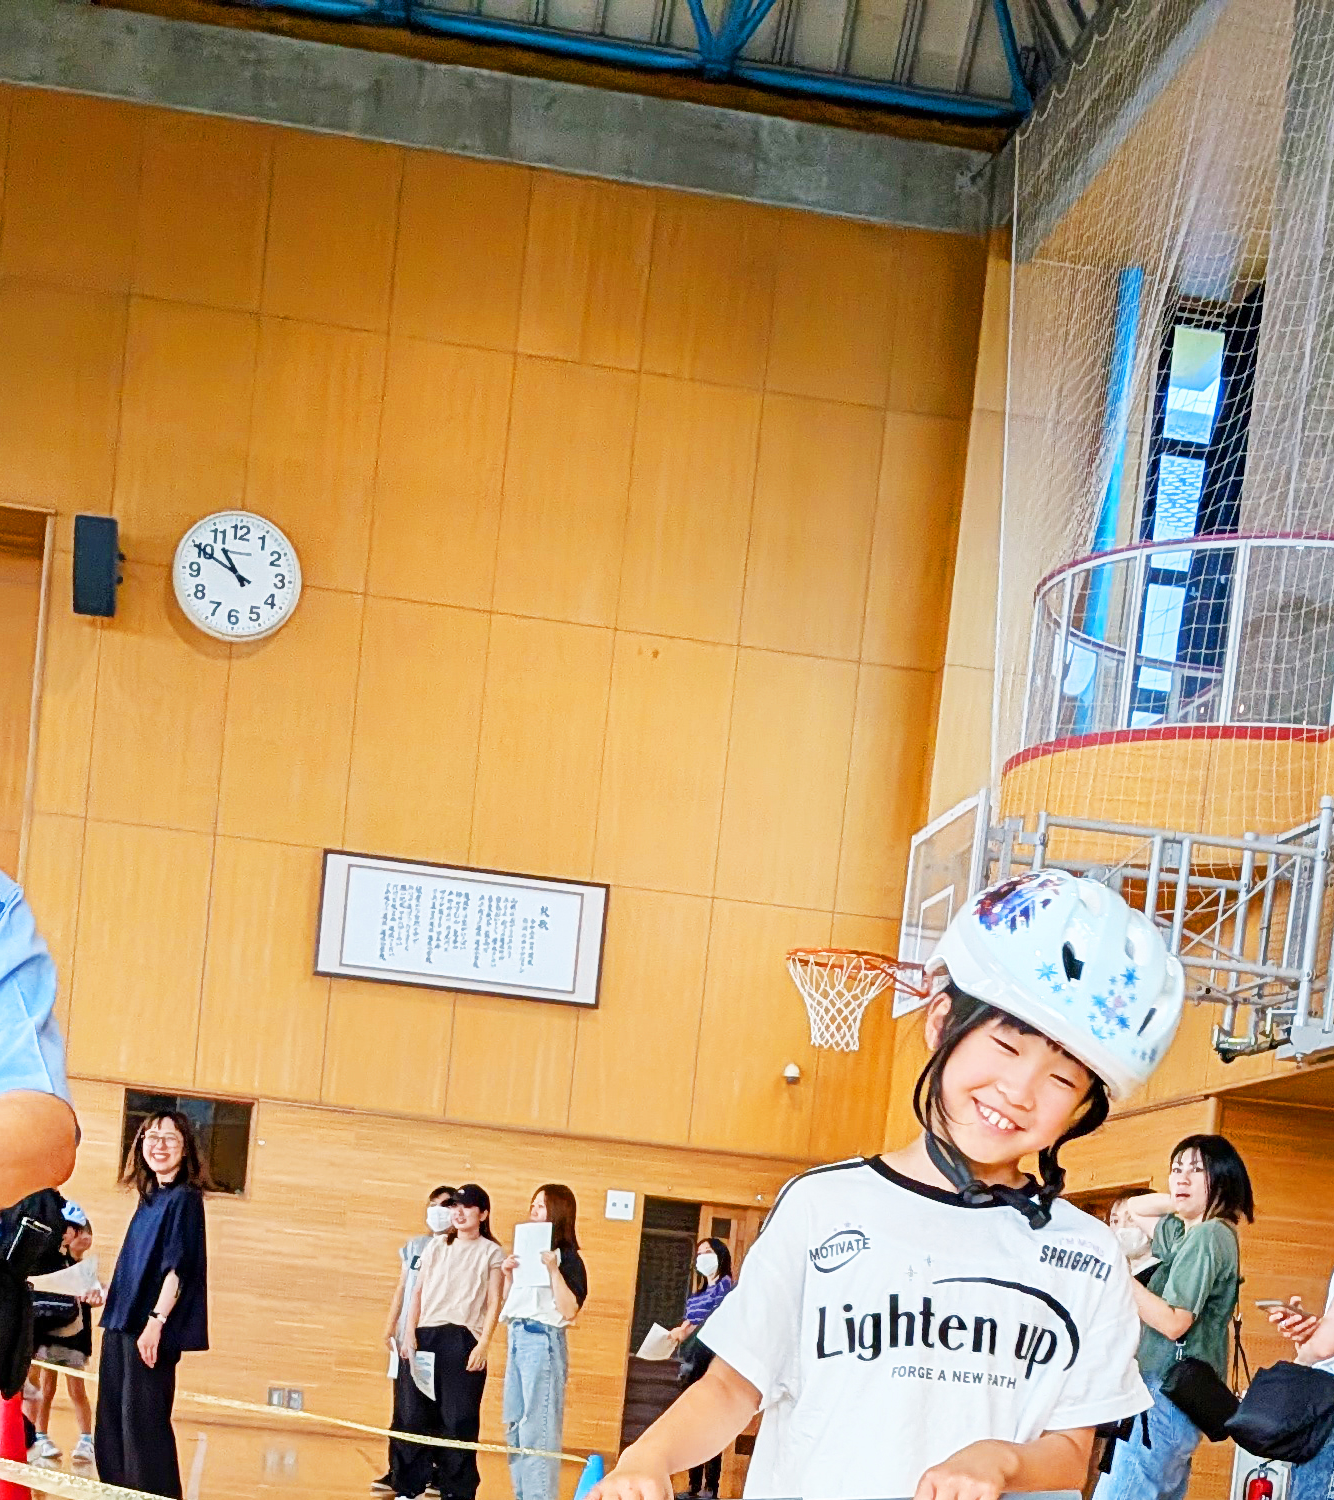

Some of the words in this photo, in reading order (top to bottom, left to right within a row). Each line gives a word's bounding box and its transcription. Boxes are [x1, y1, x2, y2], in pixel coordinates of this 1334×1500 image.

[210, 527, 227, 545] 11
[230, 523, 251, 542] 12
[257, 534, 266, 551] 1
[269, 550, 282, 567] 2
[188, 561, 201, 578] 9
[273, 573, 286, 589] 3
[193, 583, 206, 600] 8
[209, 600, 222, 617] 7
[264, 593, 276, 609] 4
[227, 609, 240, 625] 6
[248, 605, 261, 622] 5
[808, 1237, 871, 1262] MOTIVATE
[816, 1293, 998, 1362] Lighten
[1015, 1322, 1058, 1379] up
[891, 1366, 934, 1380] FORGE
[937, 1369, 947, 1381] A
[952, 1371, 984, 1385] NEW
[986, 1374, 1017, 1389] PATH
